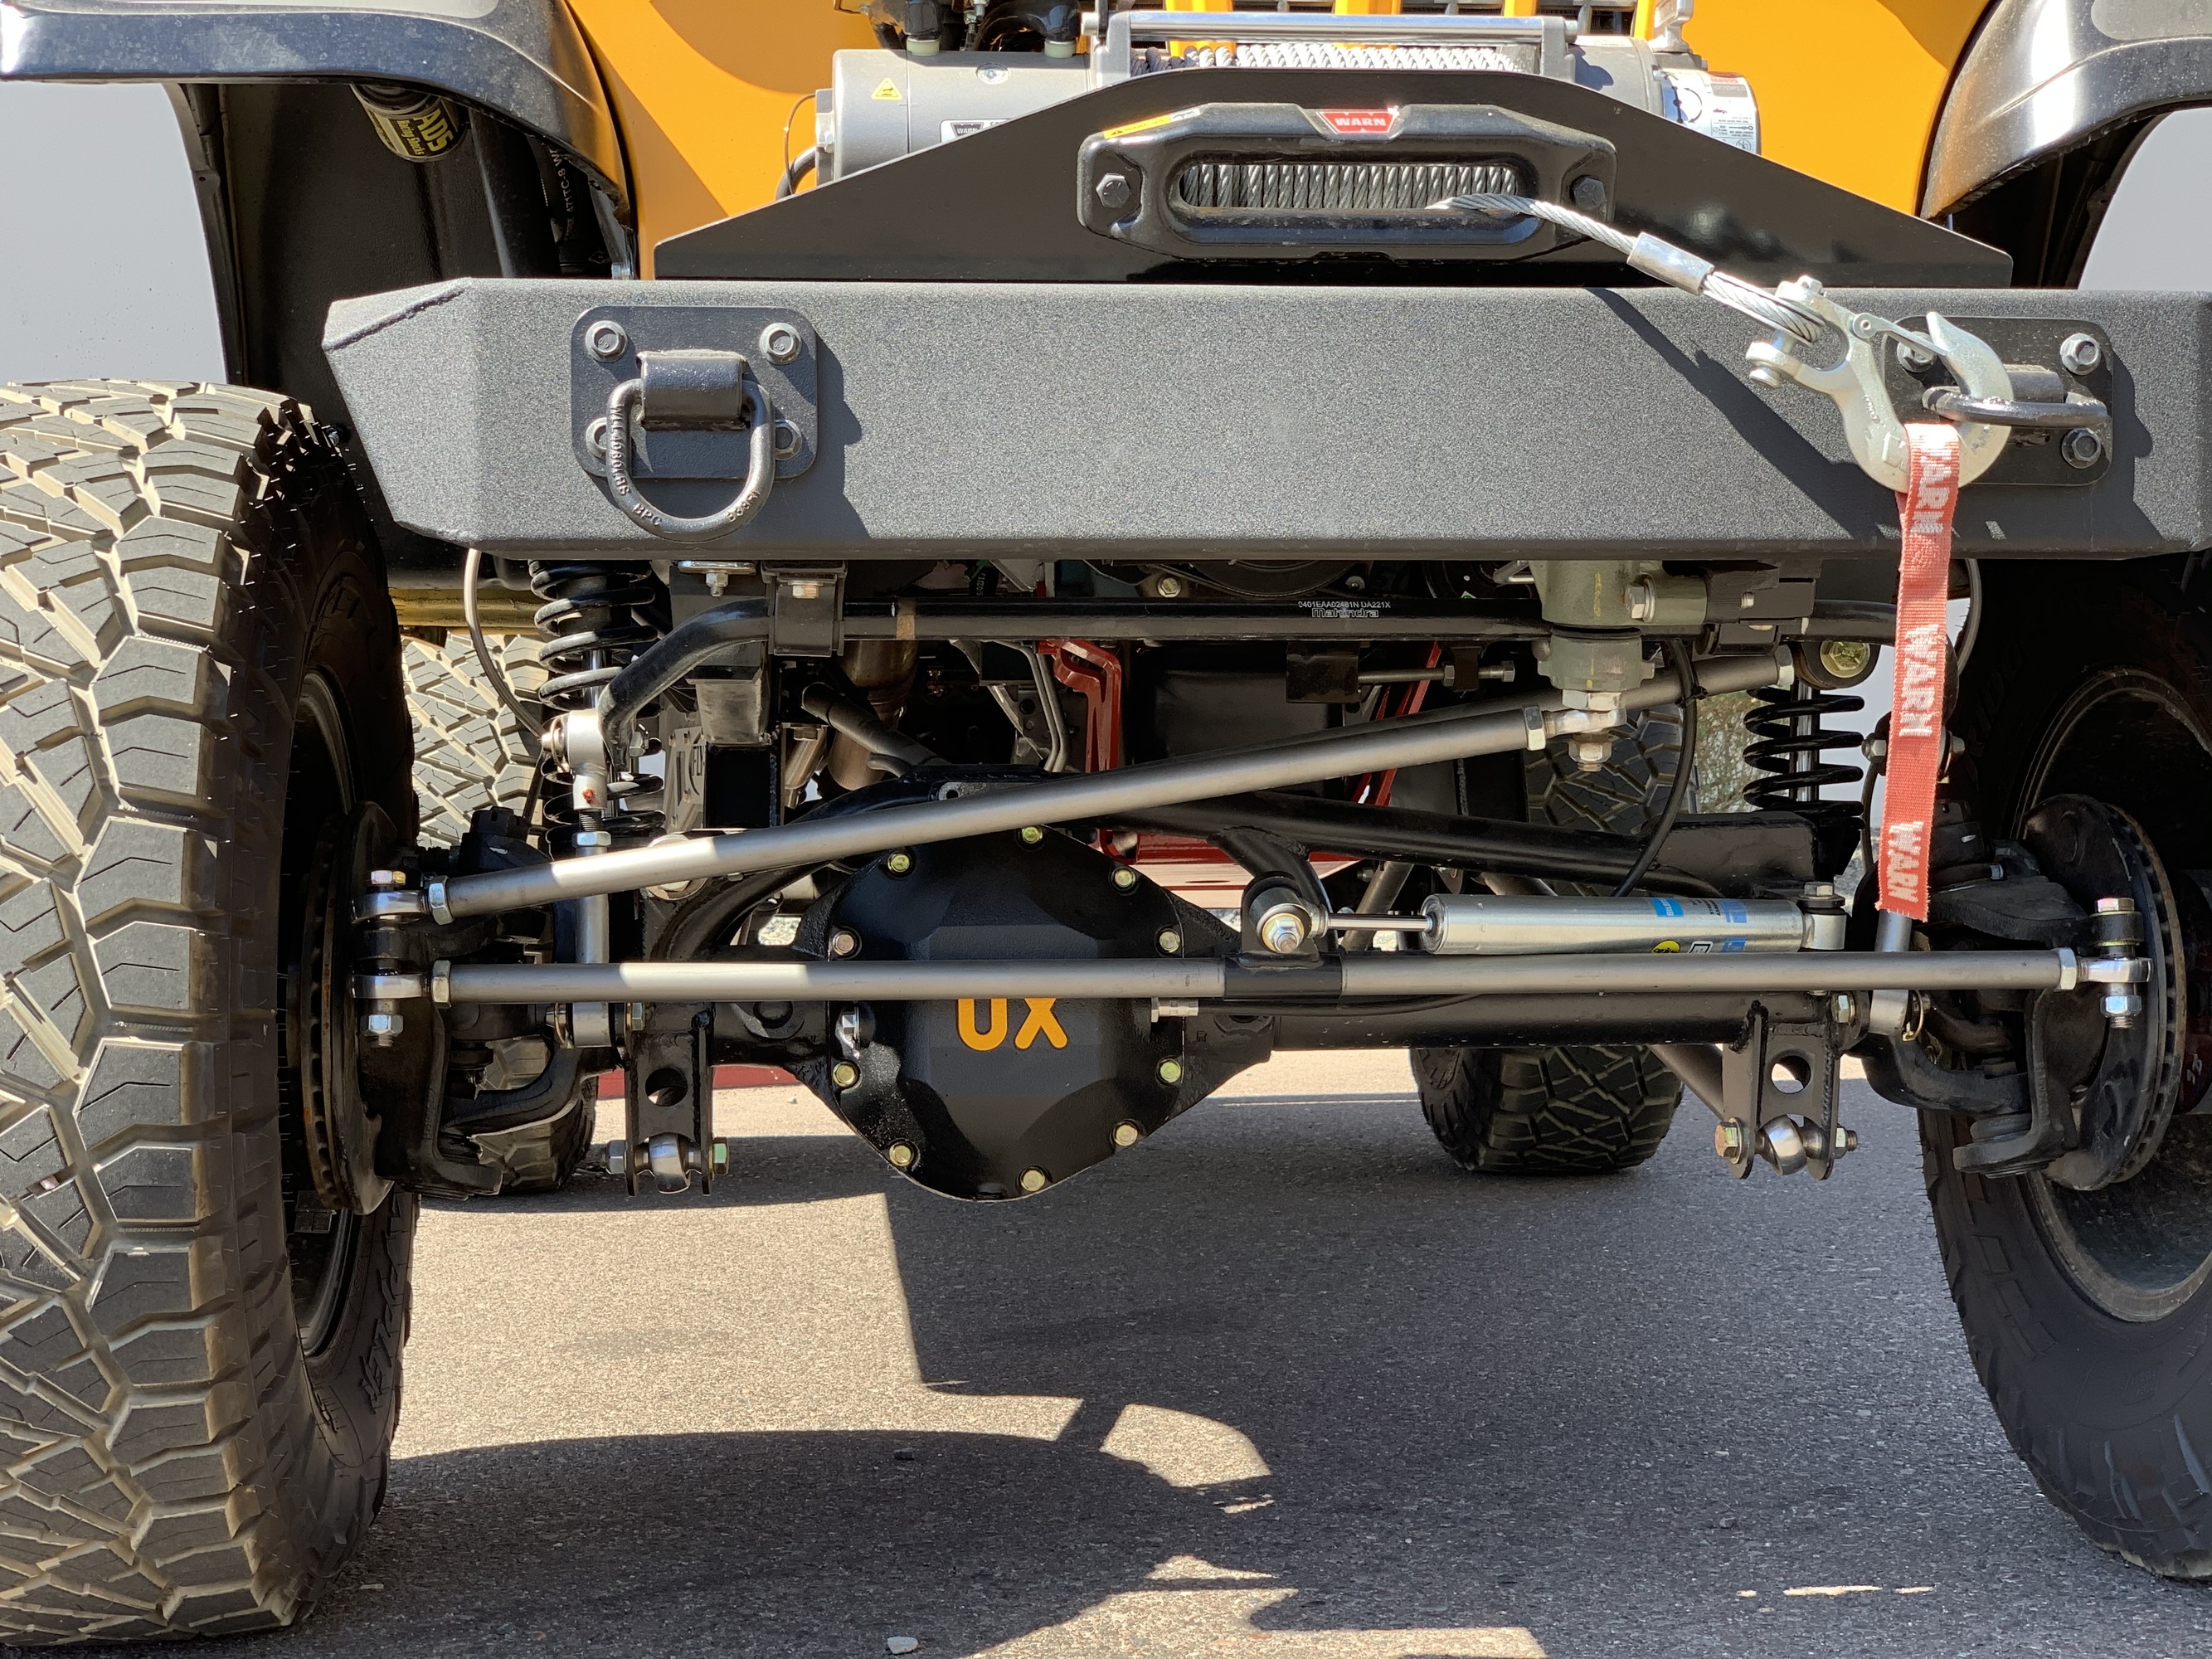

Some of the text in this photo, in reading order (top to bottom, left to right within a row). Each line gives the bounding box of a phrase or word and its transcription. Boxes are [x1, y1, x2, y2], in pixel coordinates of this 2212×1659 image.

[413, 109, 454, 152] ADS
[1334, 118, 1387, 126] WARN
[1898, 624, 1939, 737] WARN
[1886, 821, 1924, 902] WARN
[956, 997, 1069, 1052] UX
